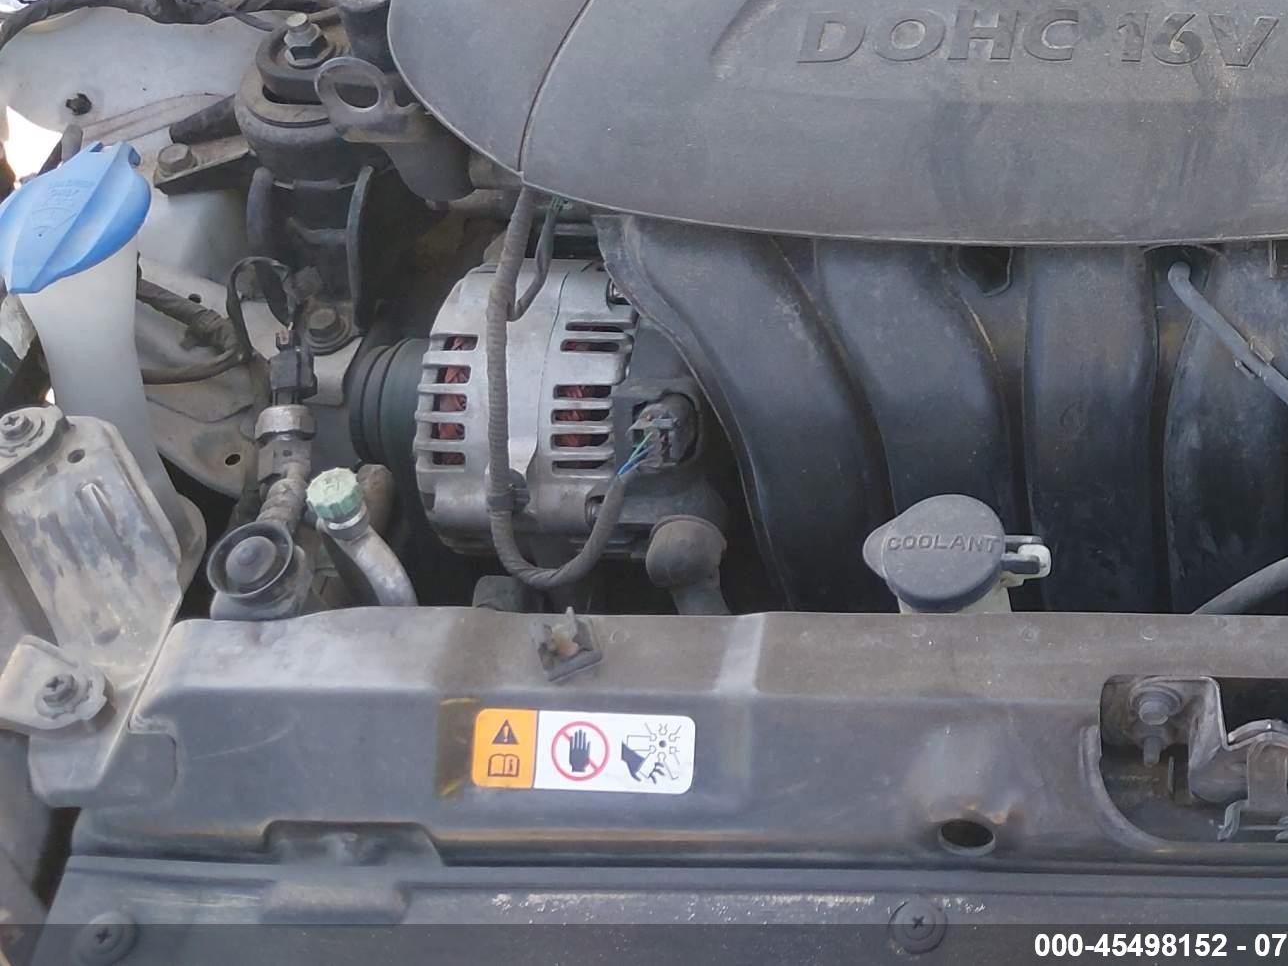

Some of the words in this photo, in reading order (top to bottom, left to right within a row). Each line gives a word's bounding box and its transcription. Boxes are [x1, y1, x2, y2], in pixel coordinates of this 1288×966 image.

[796, 9, 1081, 64] DOHC
[1116, 11, 1280, 67] 16V
[887, 534, 999, 554] COOLANT
